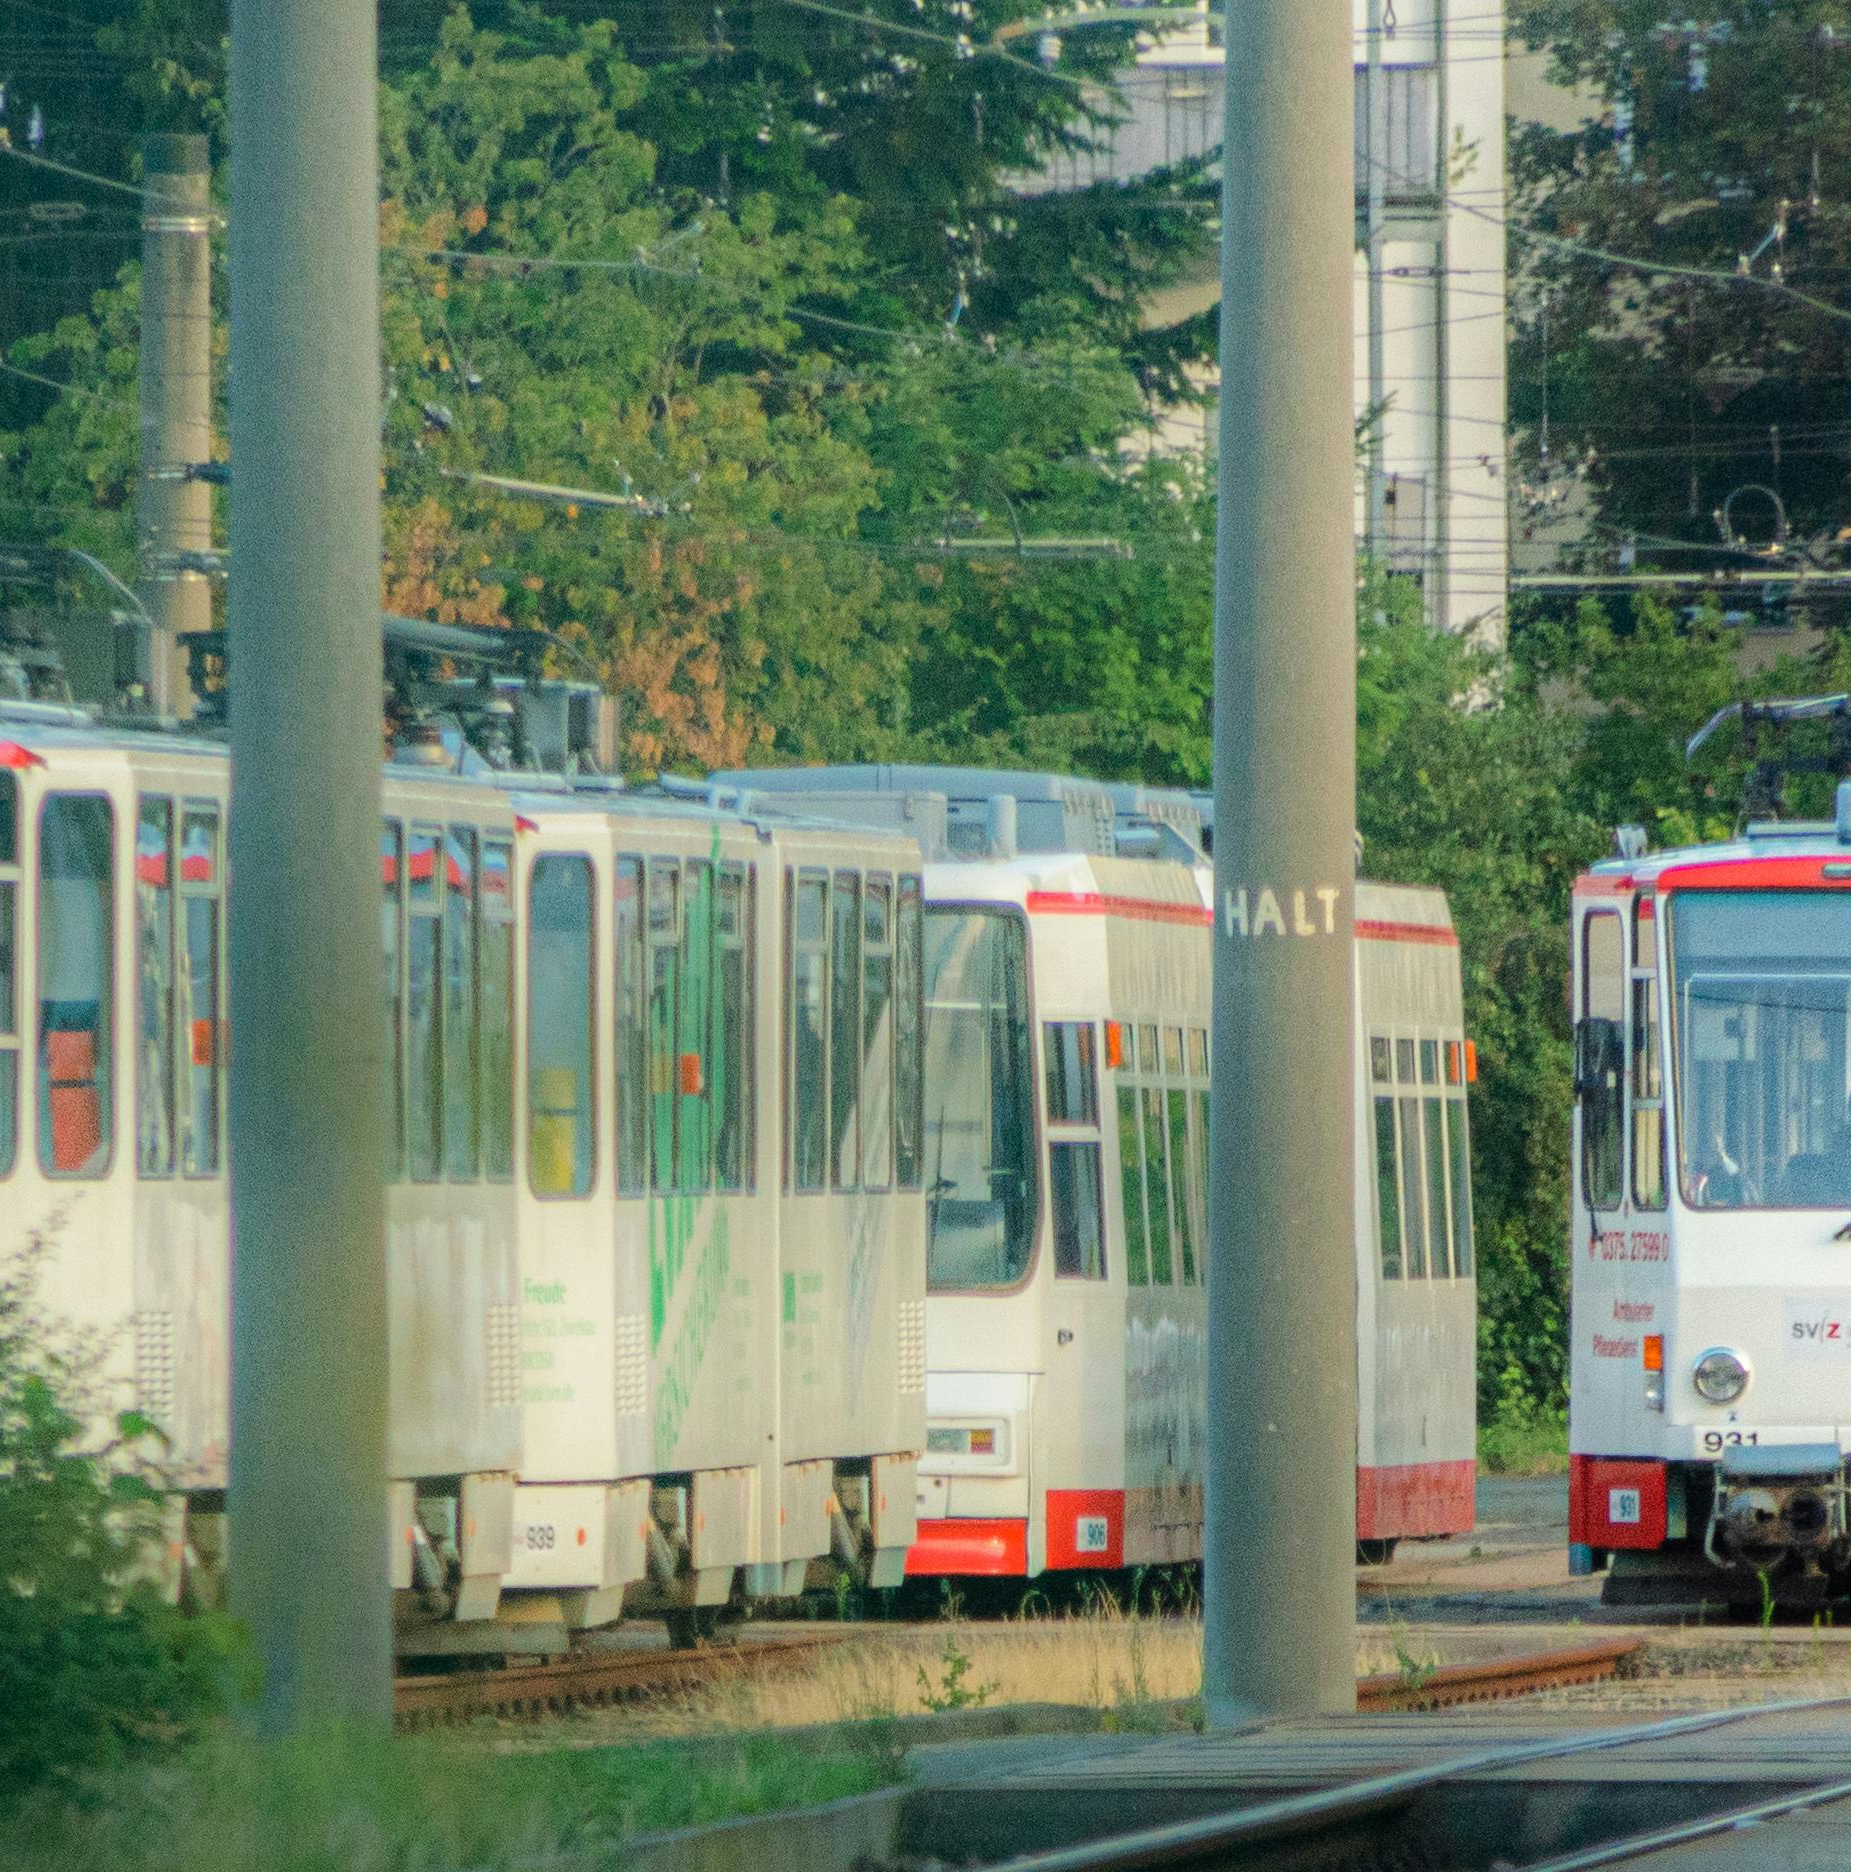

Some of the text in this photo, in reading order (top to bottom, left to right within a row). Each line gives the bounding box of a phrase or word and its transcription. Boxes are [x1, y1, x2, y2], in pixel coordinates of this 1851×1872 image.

[1225, 888, 1340, 937] HALT
[1704, 1431, 1759, 1453] 931
[527, 1526, 555, 1550] 939
